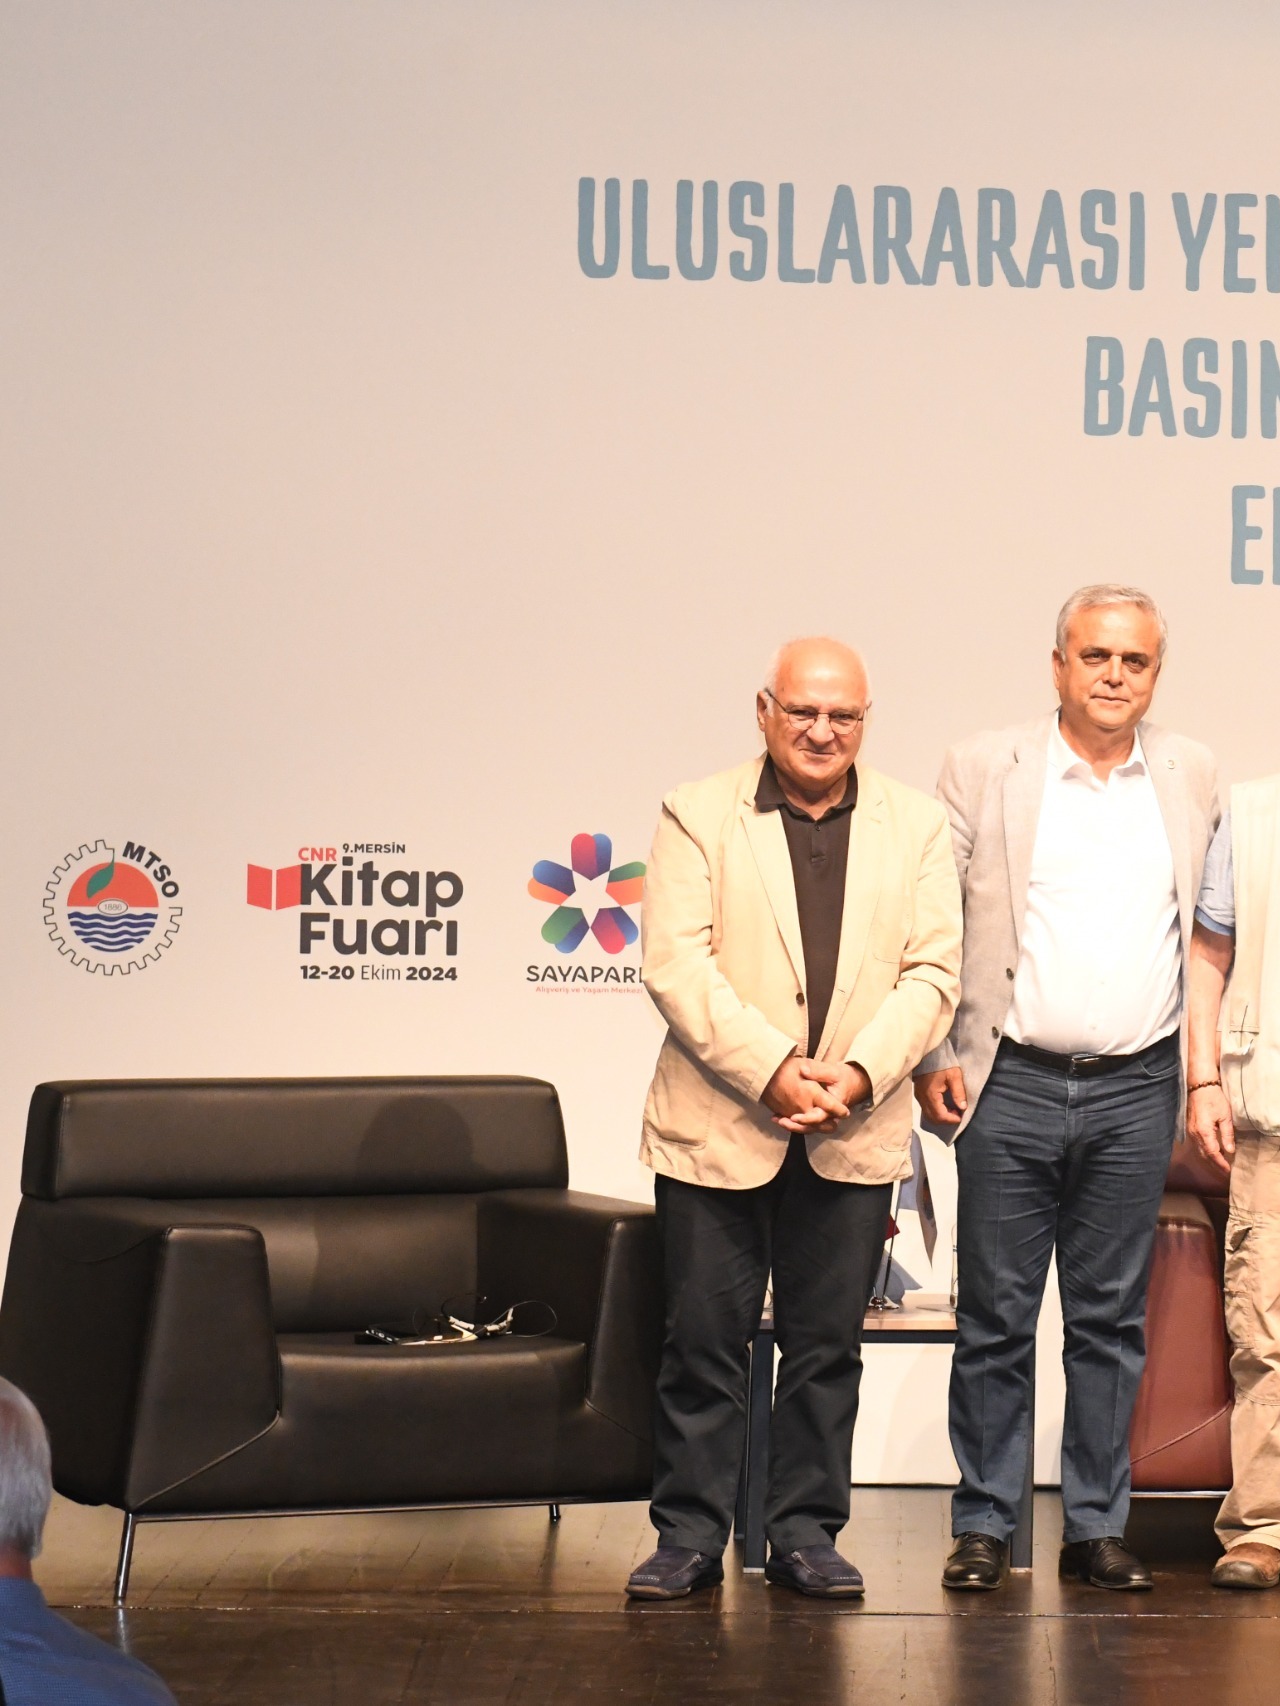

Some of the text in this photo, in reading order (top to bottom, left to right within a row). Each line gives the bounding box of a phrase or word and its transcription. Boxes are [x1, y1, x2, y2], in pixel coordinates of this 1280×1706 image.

[577, 177, 1146, 291] ULUSLARARASI
[122, 840, 180, 898] MTSO
[298, 847, 338, 862] CNR
[300, 856, 464, 918] Kitap
[104, 903, 123, 911] 1886
[299, 912, 458, 956] Fuarı
[300, 964, 458, 981] 12-20 Ekim 2024
[582, 987, 609, 995] Yaşam
